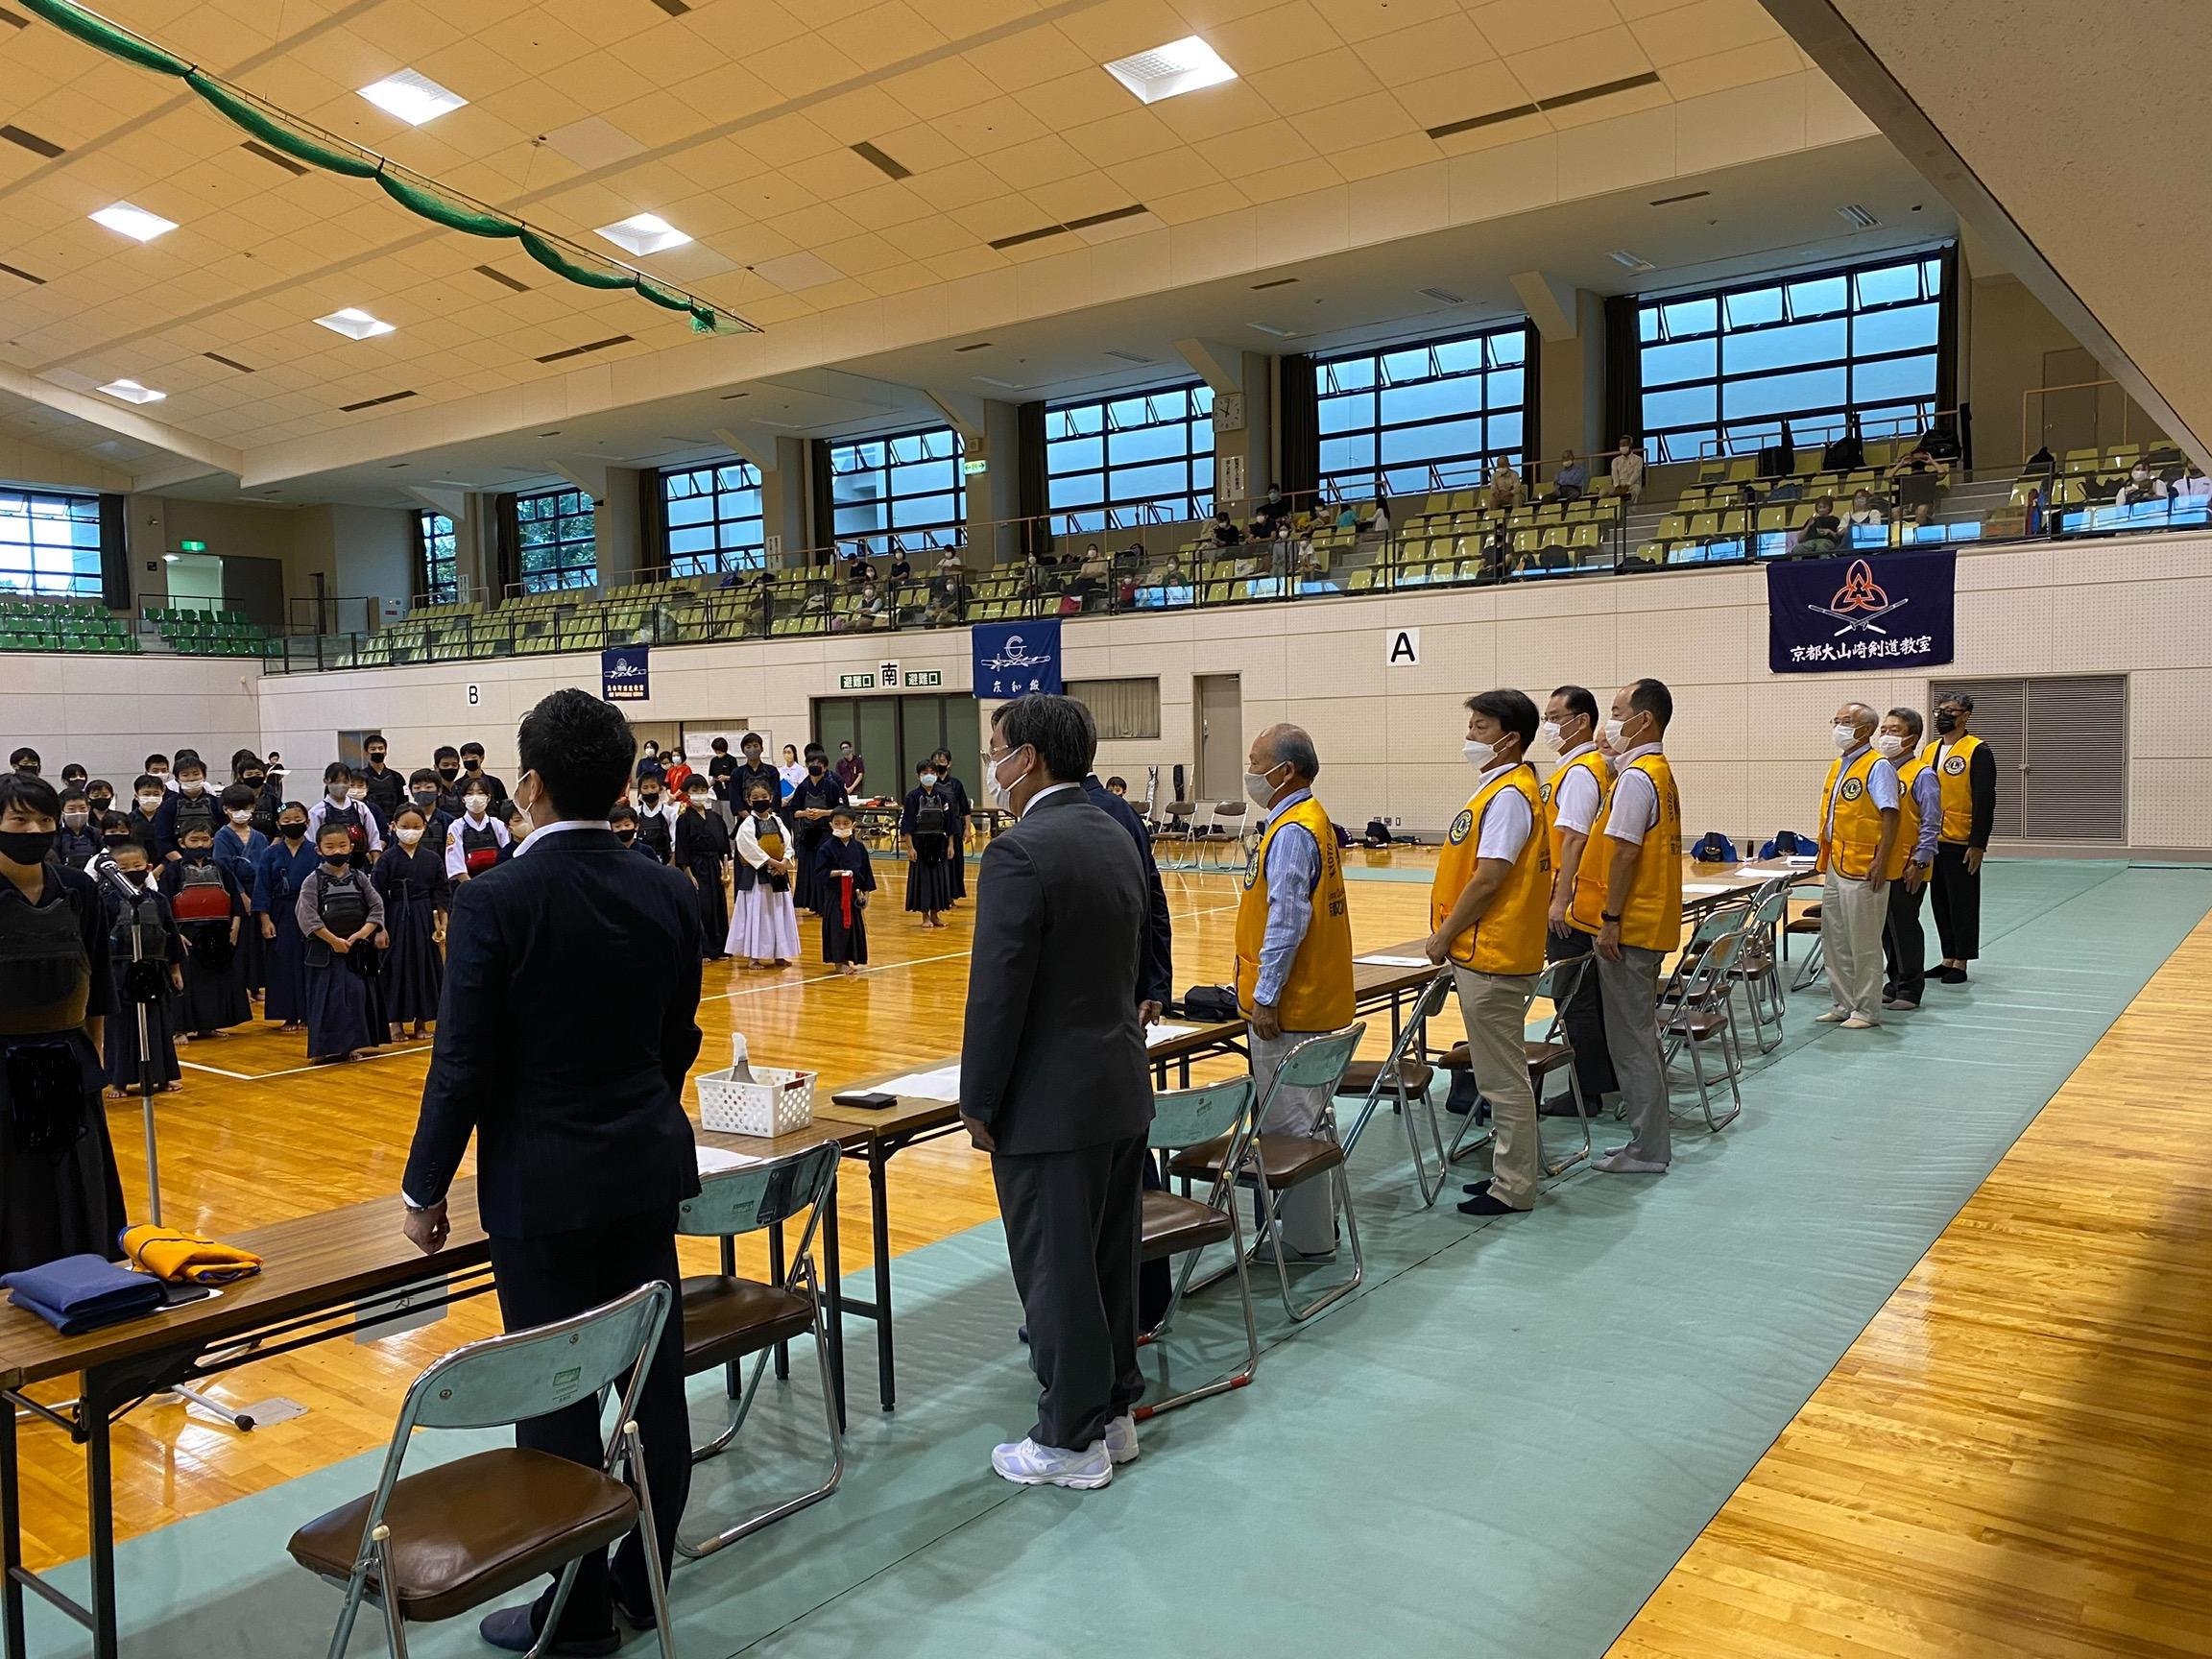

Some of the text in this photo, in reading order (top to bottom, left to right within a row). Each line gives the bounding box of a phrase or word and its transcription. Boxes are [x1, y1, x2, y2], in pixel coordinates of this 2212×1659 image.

[1391, 632, 1415, 662] A
[1790, 636, 1932, 662] 京都大山崎剣道教室
[843, 675, 872, 688] 避難口
[880, 662, 898, 685] 南
[908, 672, 938, 685] 避難口
[469, 685, 479, 705] B
